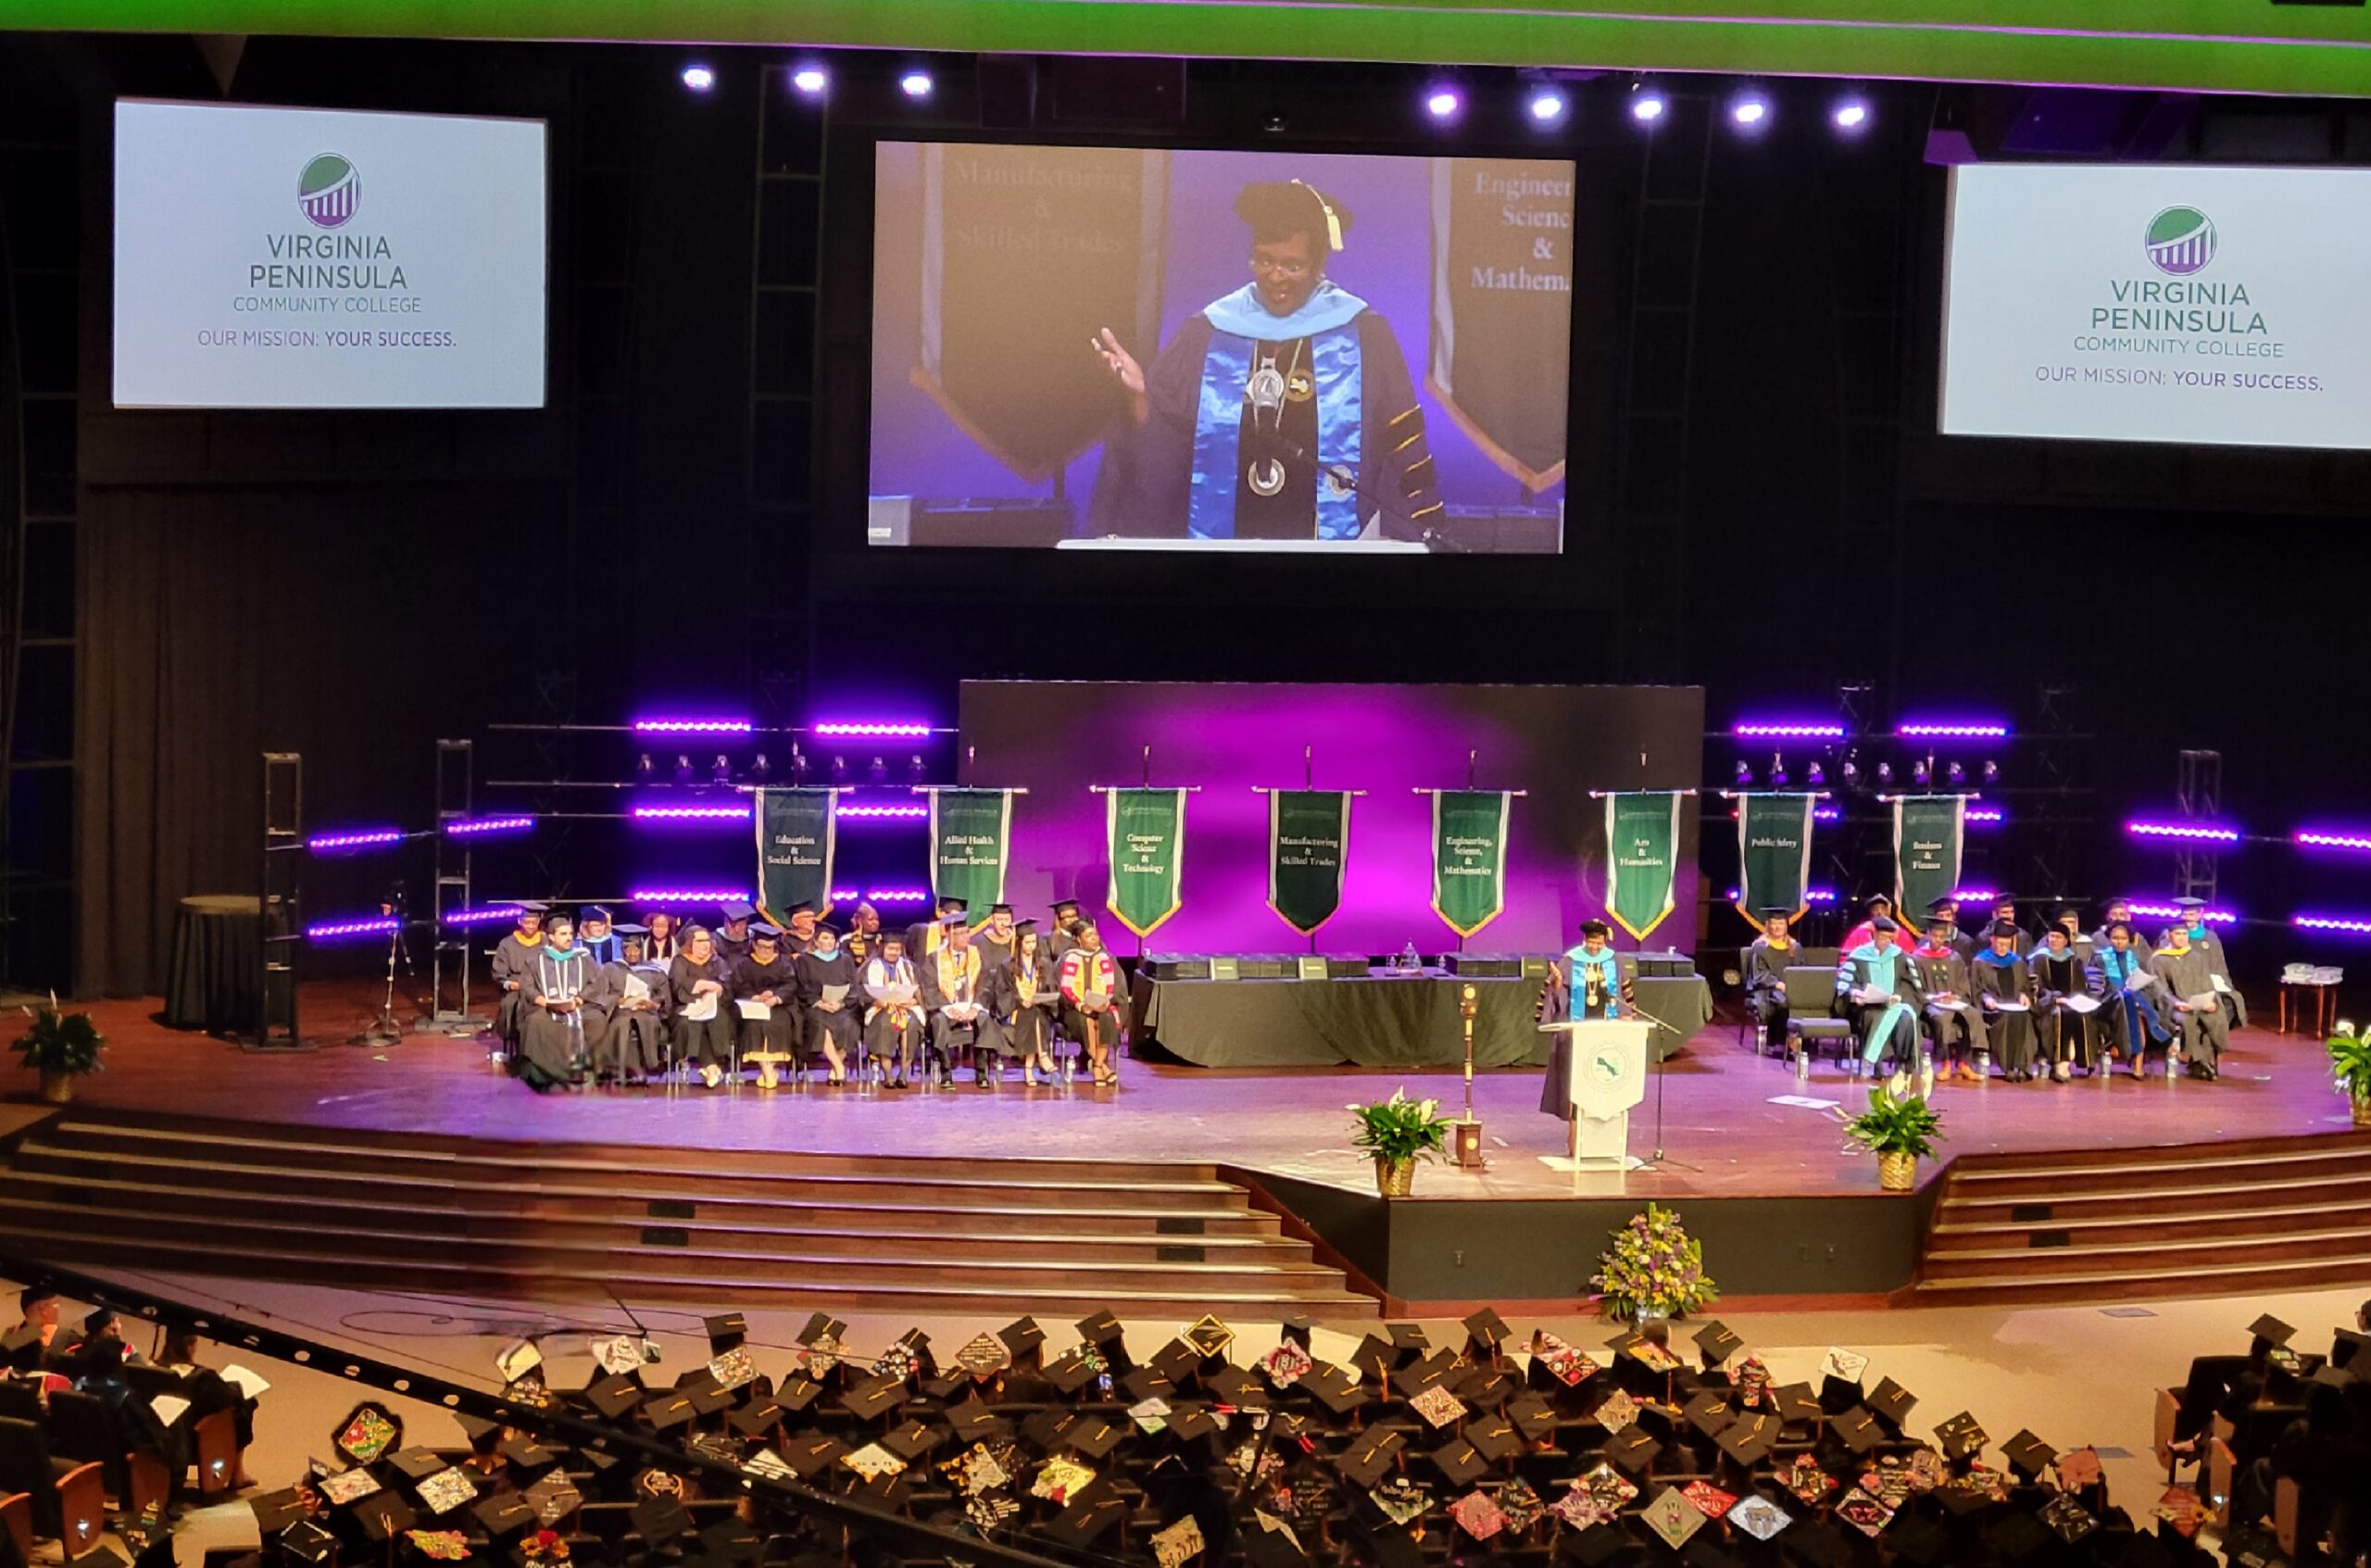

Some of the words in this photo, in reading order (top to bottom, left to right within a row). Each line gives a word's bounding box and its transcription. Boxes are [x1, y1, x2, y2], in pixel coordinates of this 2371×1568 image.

[267, 234, 393, 260] VIRGINIA
[1533, 236, 1555, 260] &
[249, 265, 408, 290] PENINSULA
[1471, 265, 1572, 292] Mathem
[2111, 280, 2251, 307] VIRGINIA
[233, 296, 340, 313] COMMUNITY
[345, 296, 422, 313] COLLEGE
[2092, 308, 2267, 334] PENINSULA
[197, 330, 237, 346] OUR
[243, 330, 319, 347] MISSION:
[324, 331, 372, 347] YOUR
[378, 331, 458, 348] SUCCESS.
[2074, 336, 2189, 355] COMMUNITY
[2196, 340, 2285, 358] COLLEGE
[2036, 366, 2077, 383] OUR
[2084, 368, 2166, 386] MISSION:
[2174, 370, 2227, 388] YOUR
[2233, 373, 2324, 393] SUCCESS.
[775, 834, 815, 845] Education
[969, 835, 994, 845] Health
[1126, 834, 1164, 845] Computer
[1280, 836, 1339, 849] Manufacturing
[1751, 837, 1775, 847] Public
[964, 846, 973, 855] &
[767, 855, 791, 865] Social
[792, 856, 822, 865] Science
[939, 856, 969, 865] Human
[1280, 856, 1309, 865] Skilled
[1310, 858, 1336, 867] Trades
[1620, 857, 1663, 867] Humanities
[1122, 863, 1164, 874] Technology
[1444, 866, 1492, 875] Mathematics
